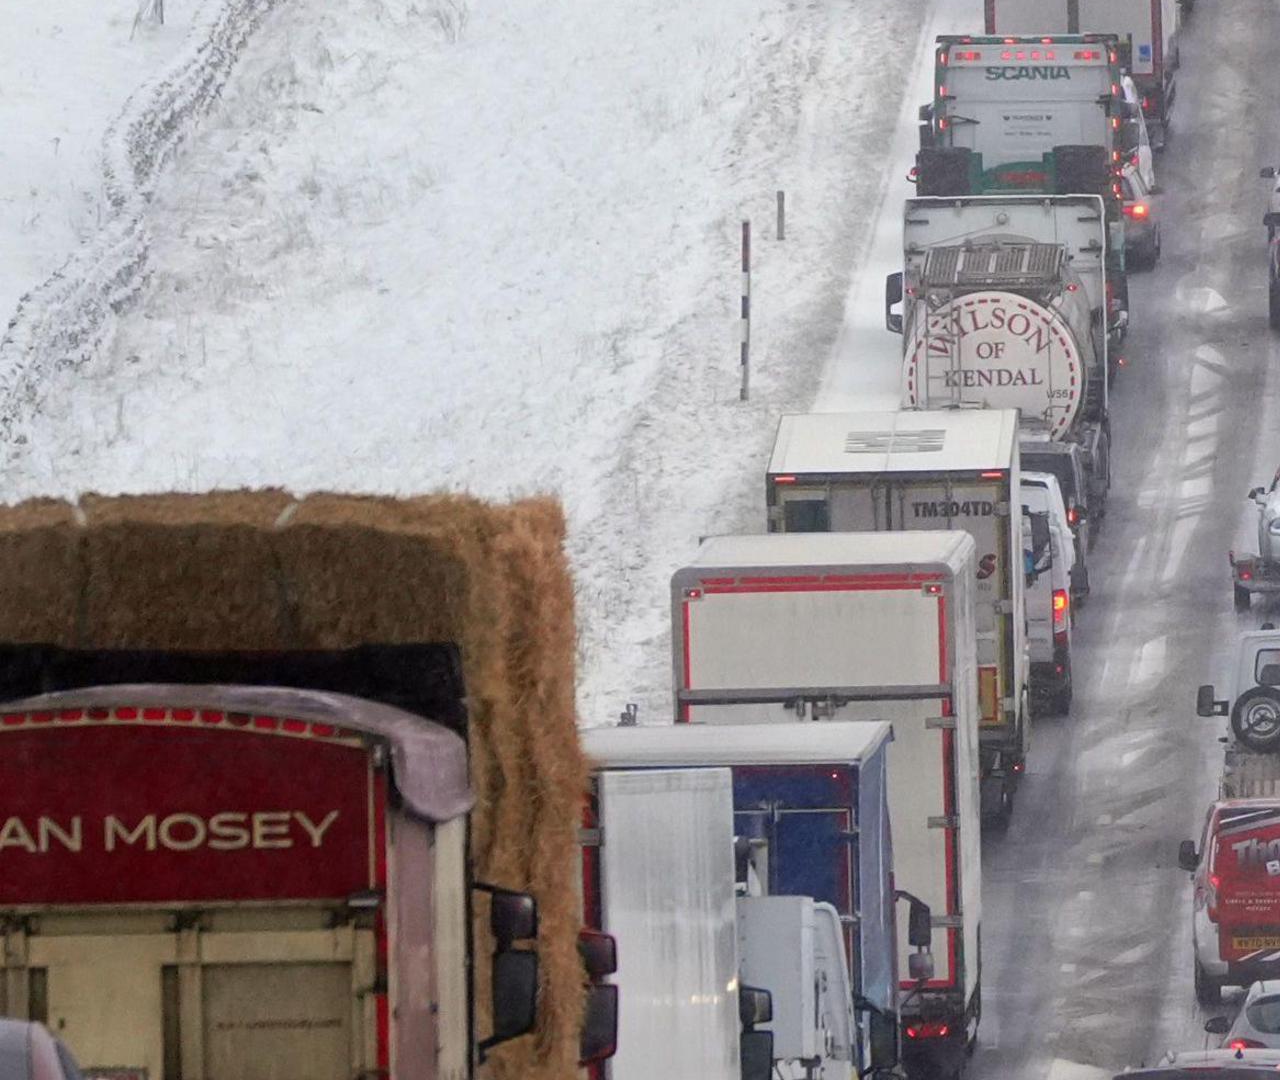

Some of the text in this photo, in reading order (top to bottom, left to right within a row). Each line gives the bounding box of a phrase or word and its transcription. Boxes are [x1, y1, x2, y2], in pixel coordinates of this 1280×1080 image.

[985, 66, 1071, 80] SCANIA
[928, 307, 1053, 356] WILSON
[976, 342, 1005, 359] OF
[944, 368, 1043, 388] KENDAL
[104, 809, 341, 852] MOSEY
